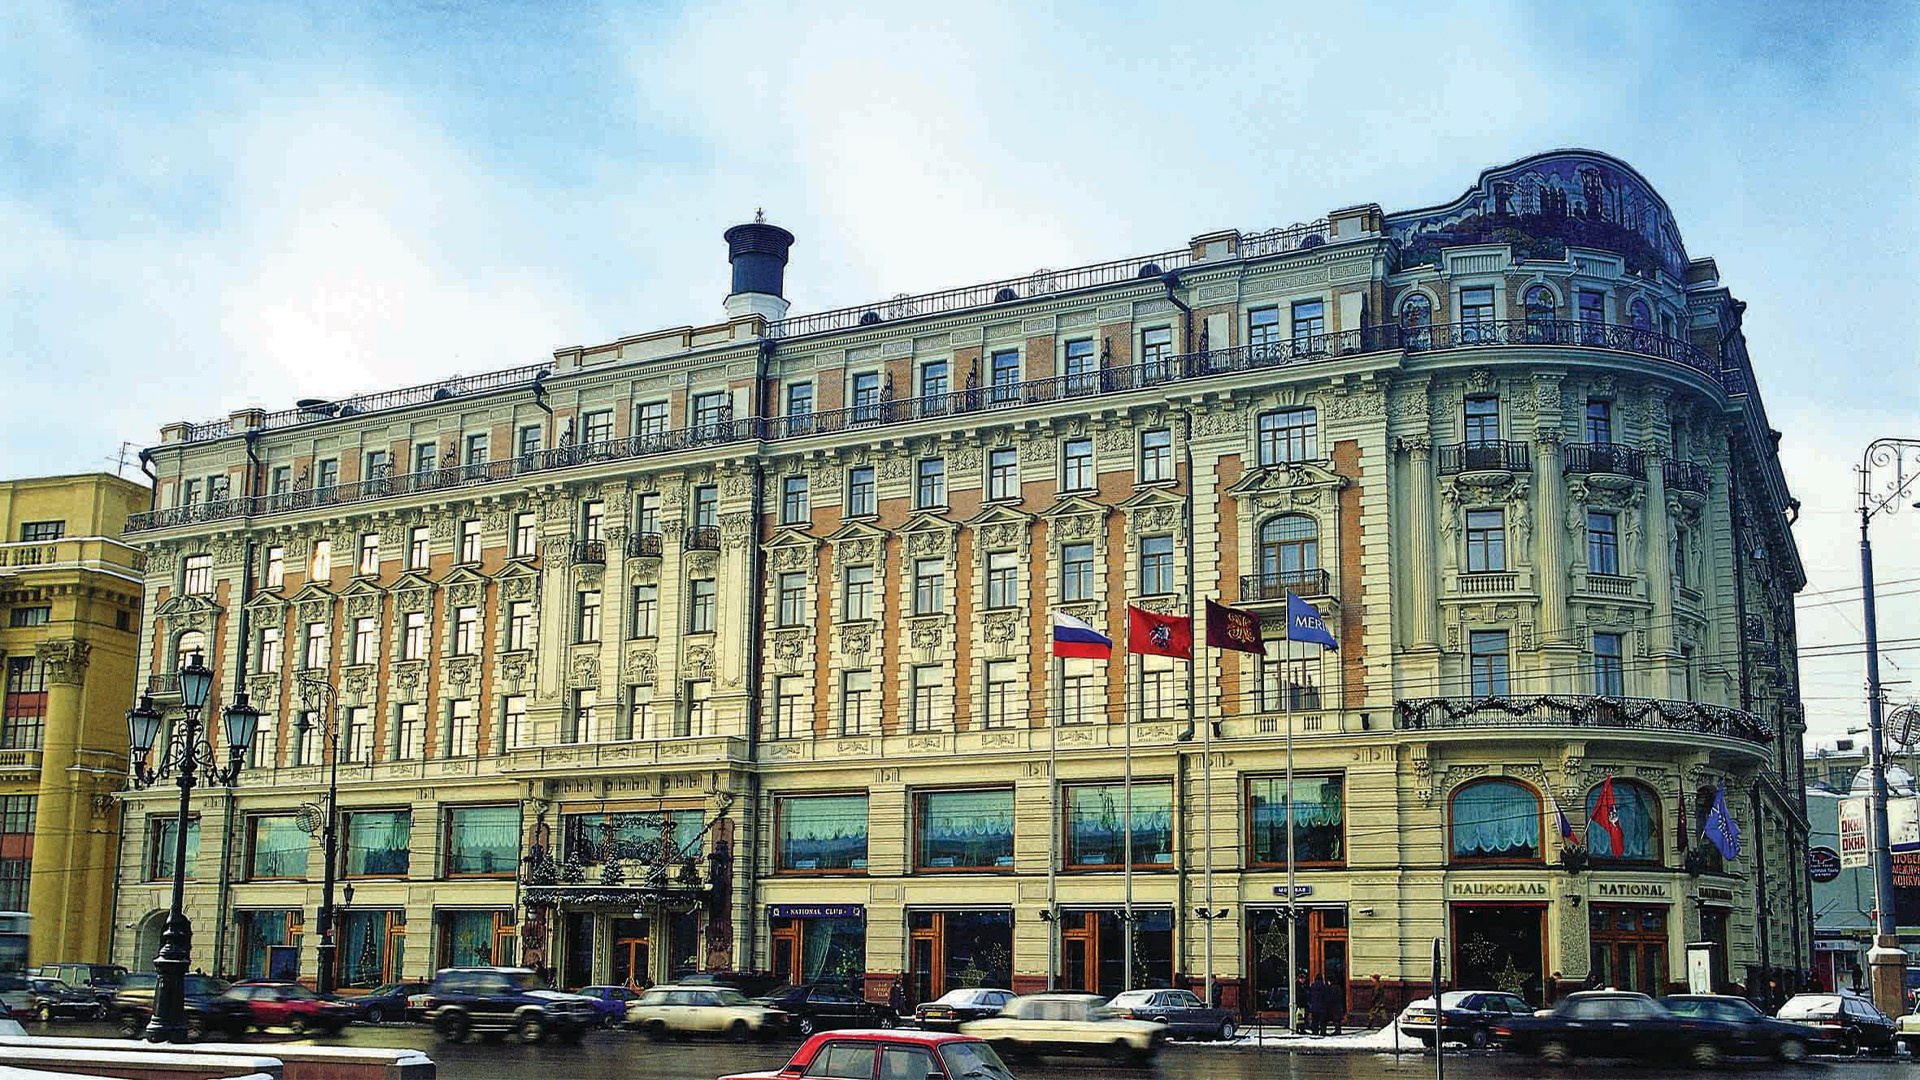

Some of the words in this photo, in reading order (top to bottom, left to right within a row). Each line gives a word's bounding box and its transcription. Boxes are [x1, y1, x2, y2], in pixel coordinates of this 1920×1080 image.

[1842, 819, 1864, 833] ОКН
[1842, 836, 1866, 851] ОКНА
[1453, 883, 1546, 894] НАЦИОНАЛЬ
[1598, 883, 1665, 896] NATIONAL
